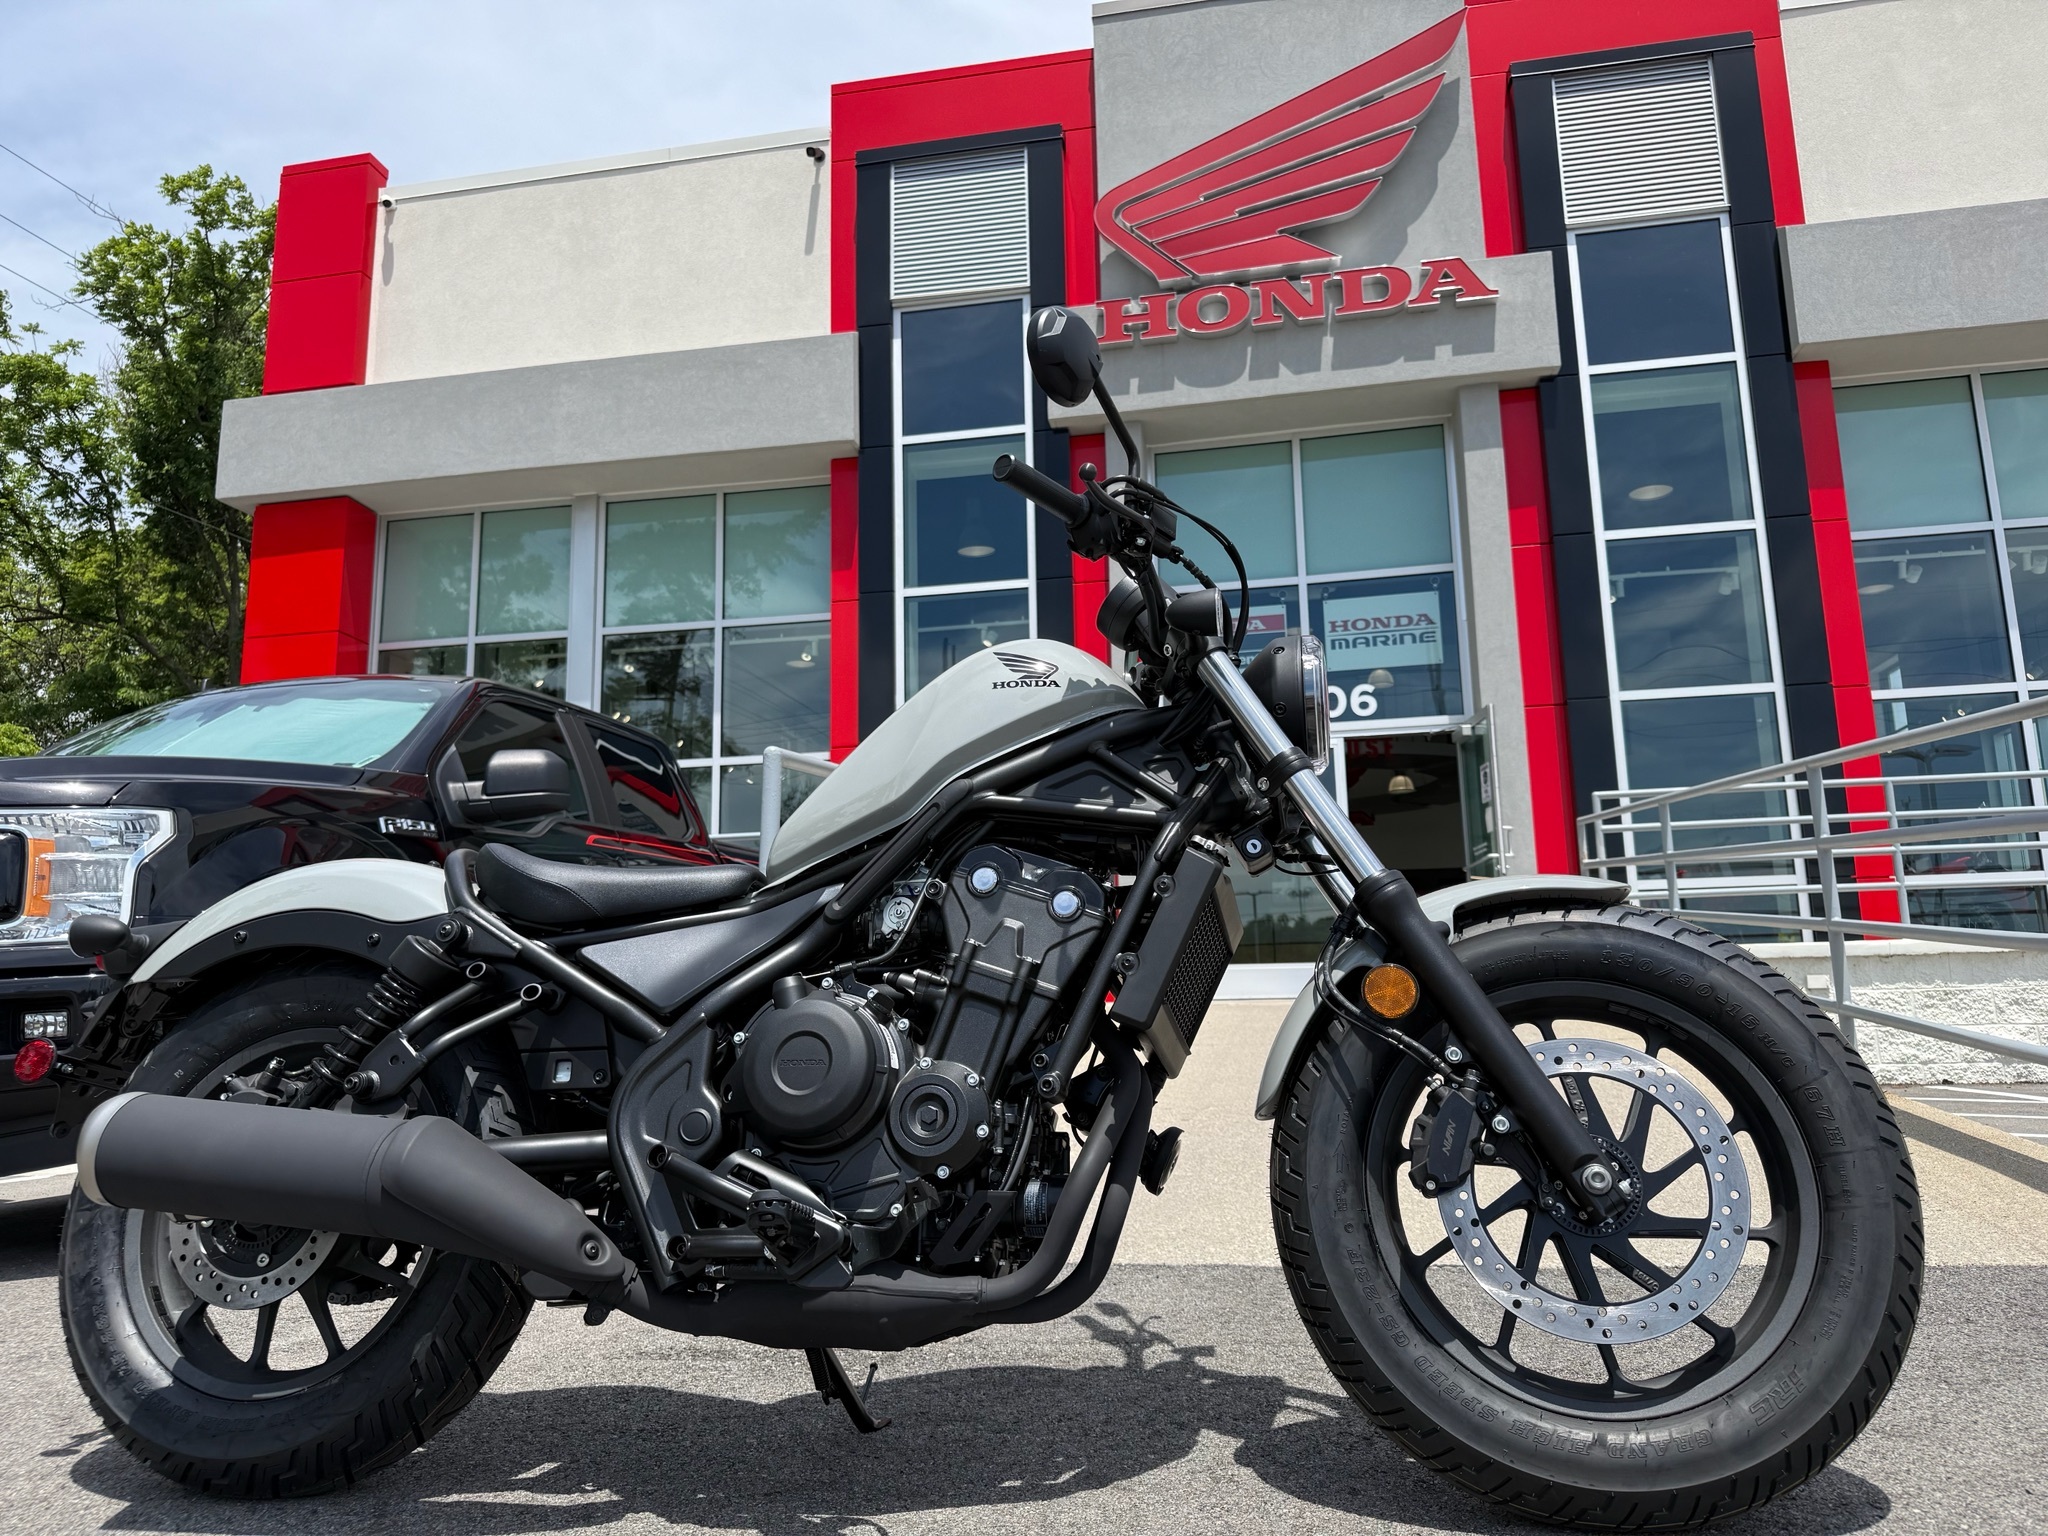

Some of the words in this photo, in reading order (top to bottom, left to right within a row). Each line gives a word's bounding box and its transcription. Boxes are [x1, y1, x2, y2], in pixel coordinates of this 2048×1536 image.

[1095, 257, 1499, 345] HONDA
[1328, 613, 1437, 633] HONDA
[992, 680, 1061, 689] HONDA
[779, 1059, 827, 1068] HONDA
[1413, 1355, 1500, 1423] SPEED
[1508, 1418, 1591, 1455] HIGH
[1607, 1428, 1713, 1459] GRAND
